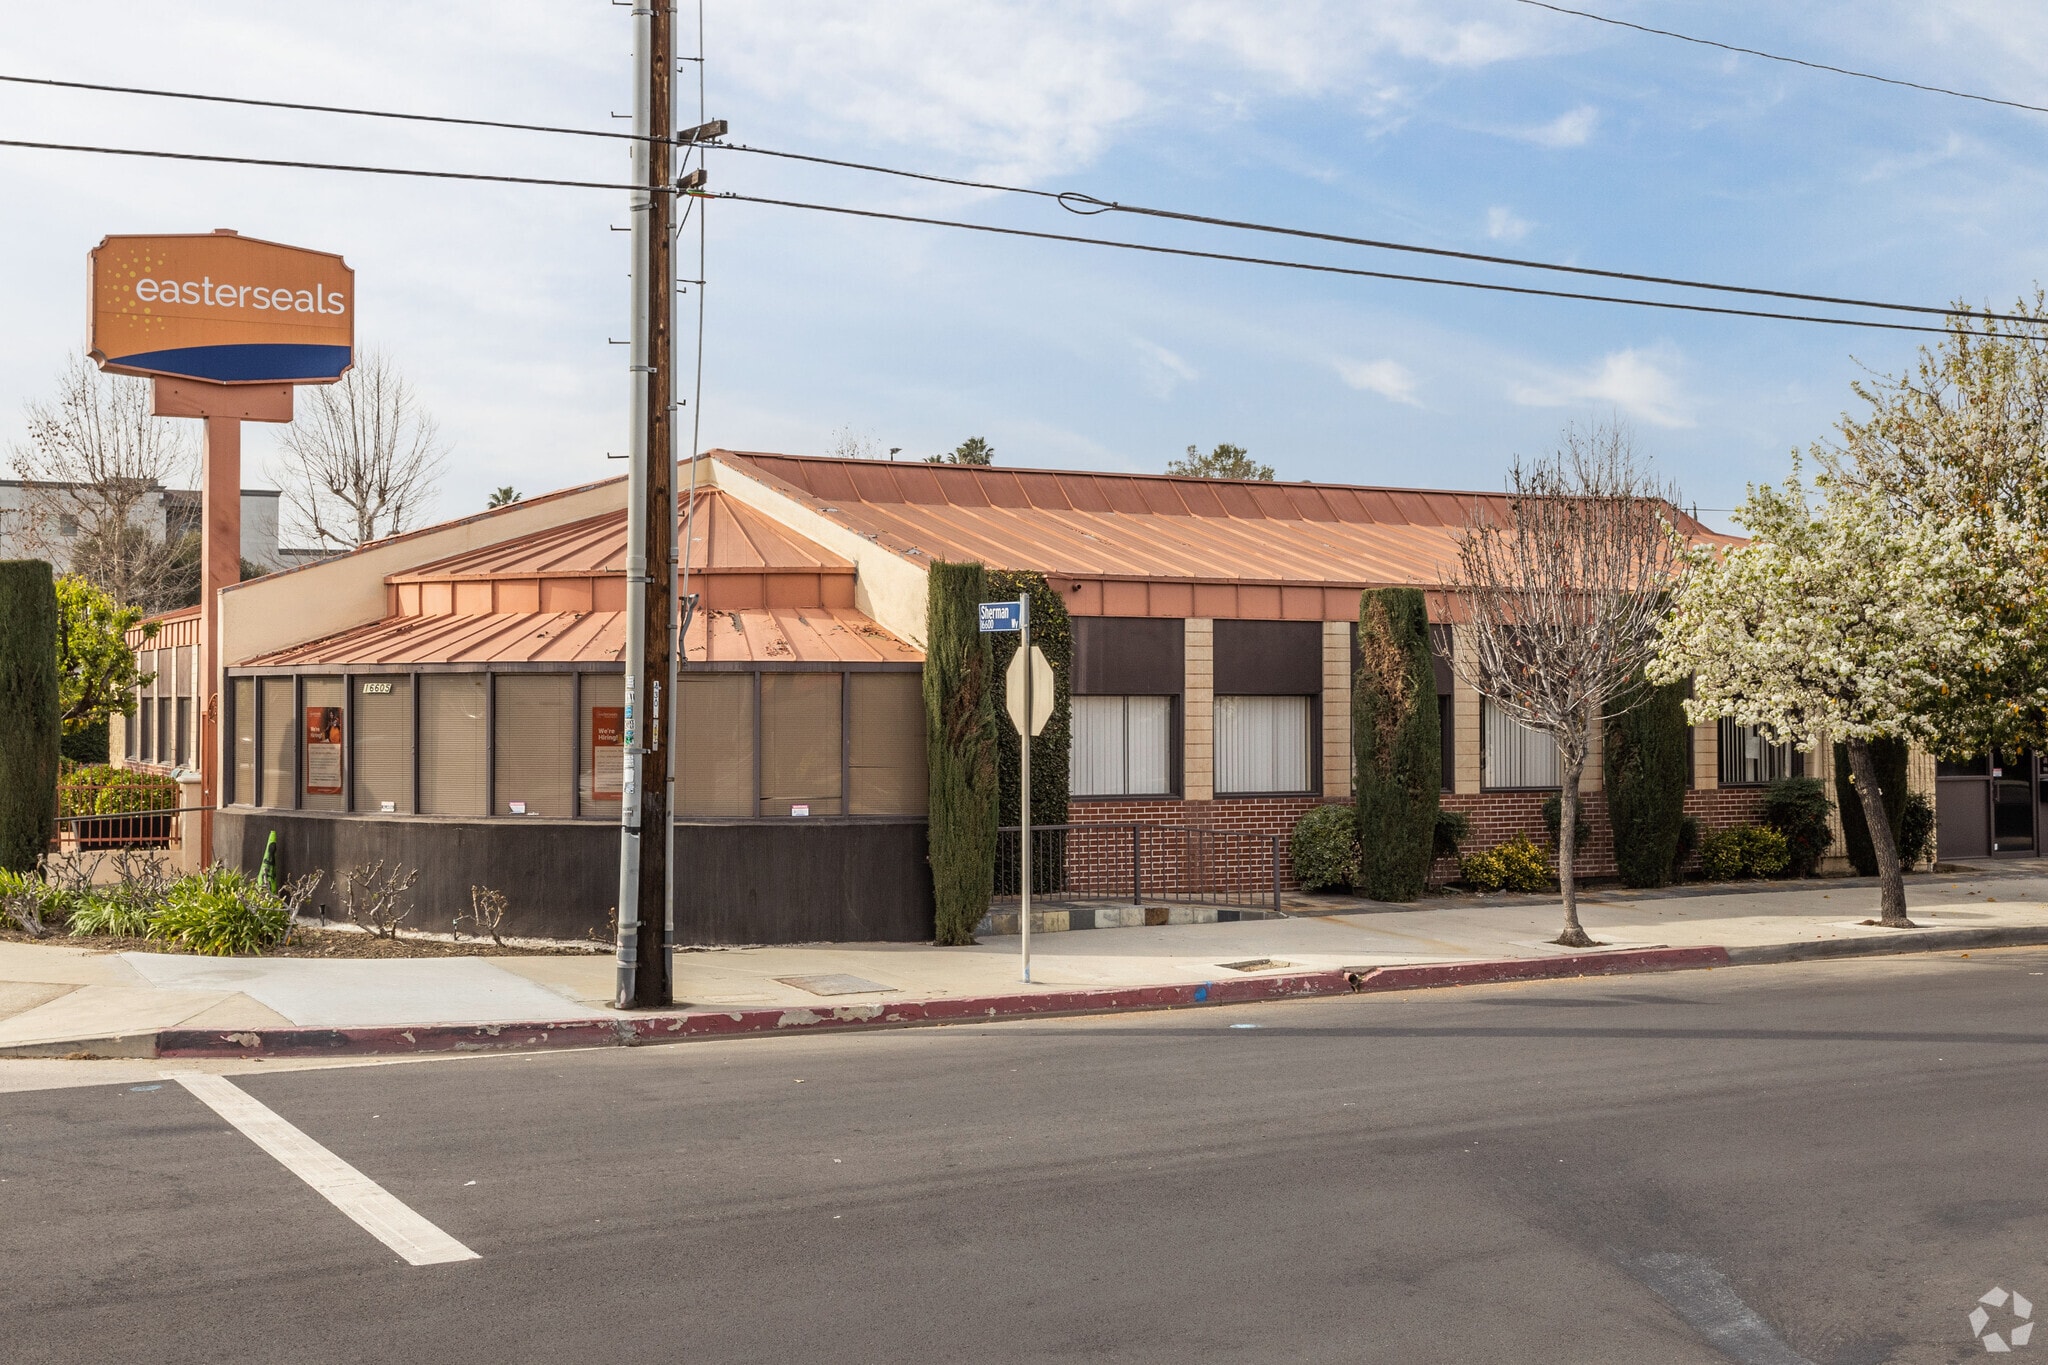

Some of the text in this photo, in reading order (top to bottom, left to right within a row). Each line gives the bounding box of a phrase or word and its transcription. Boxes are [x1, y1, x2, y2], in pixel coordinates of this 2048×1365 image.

[135, 276, 346, 315] easterseals
[981, 606, 1009, 619] Sherman
[365, 684, 390, 693] 16605
